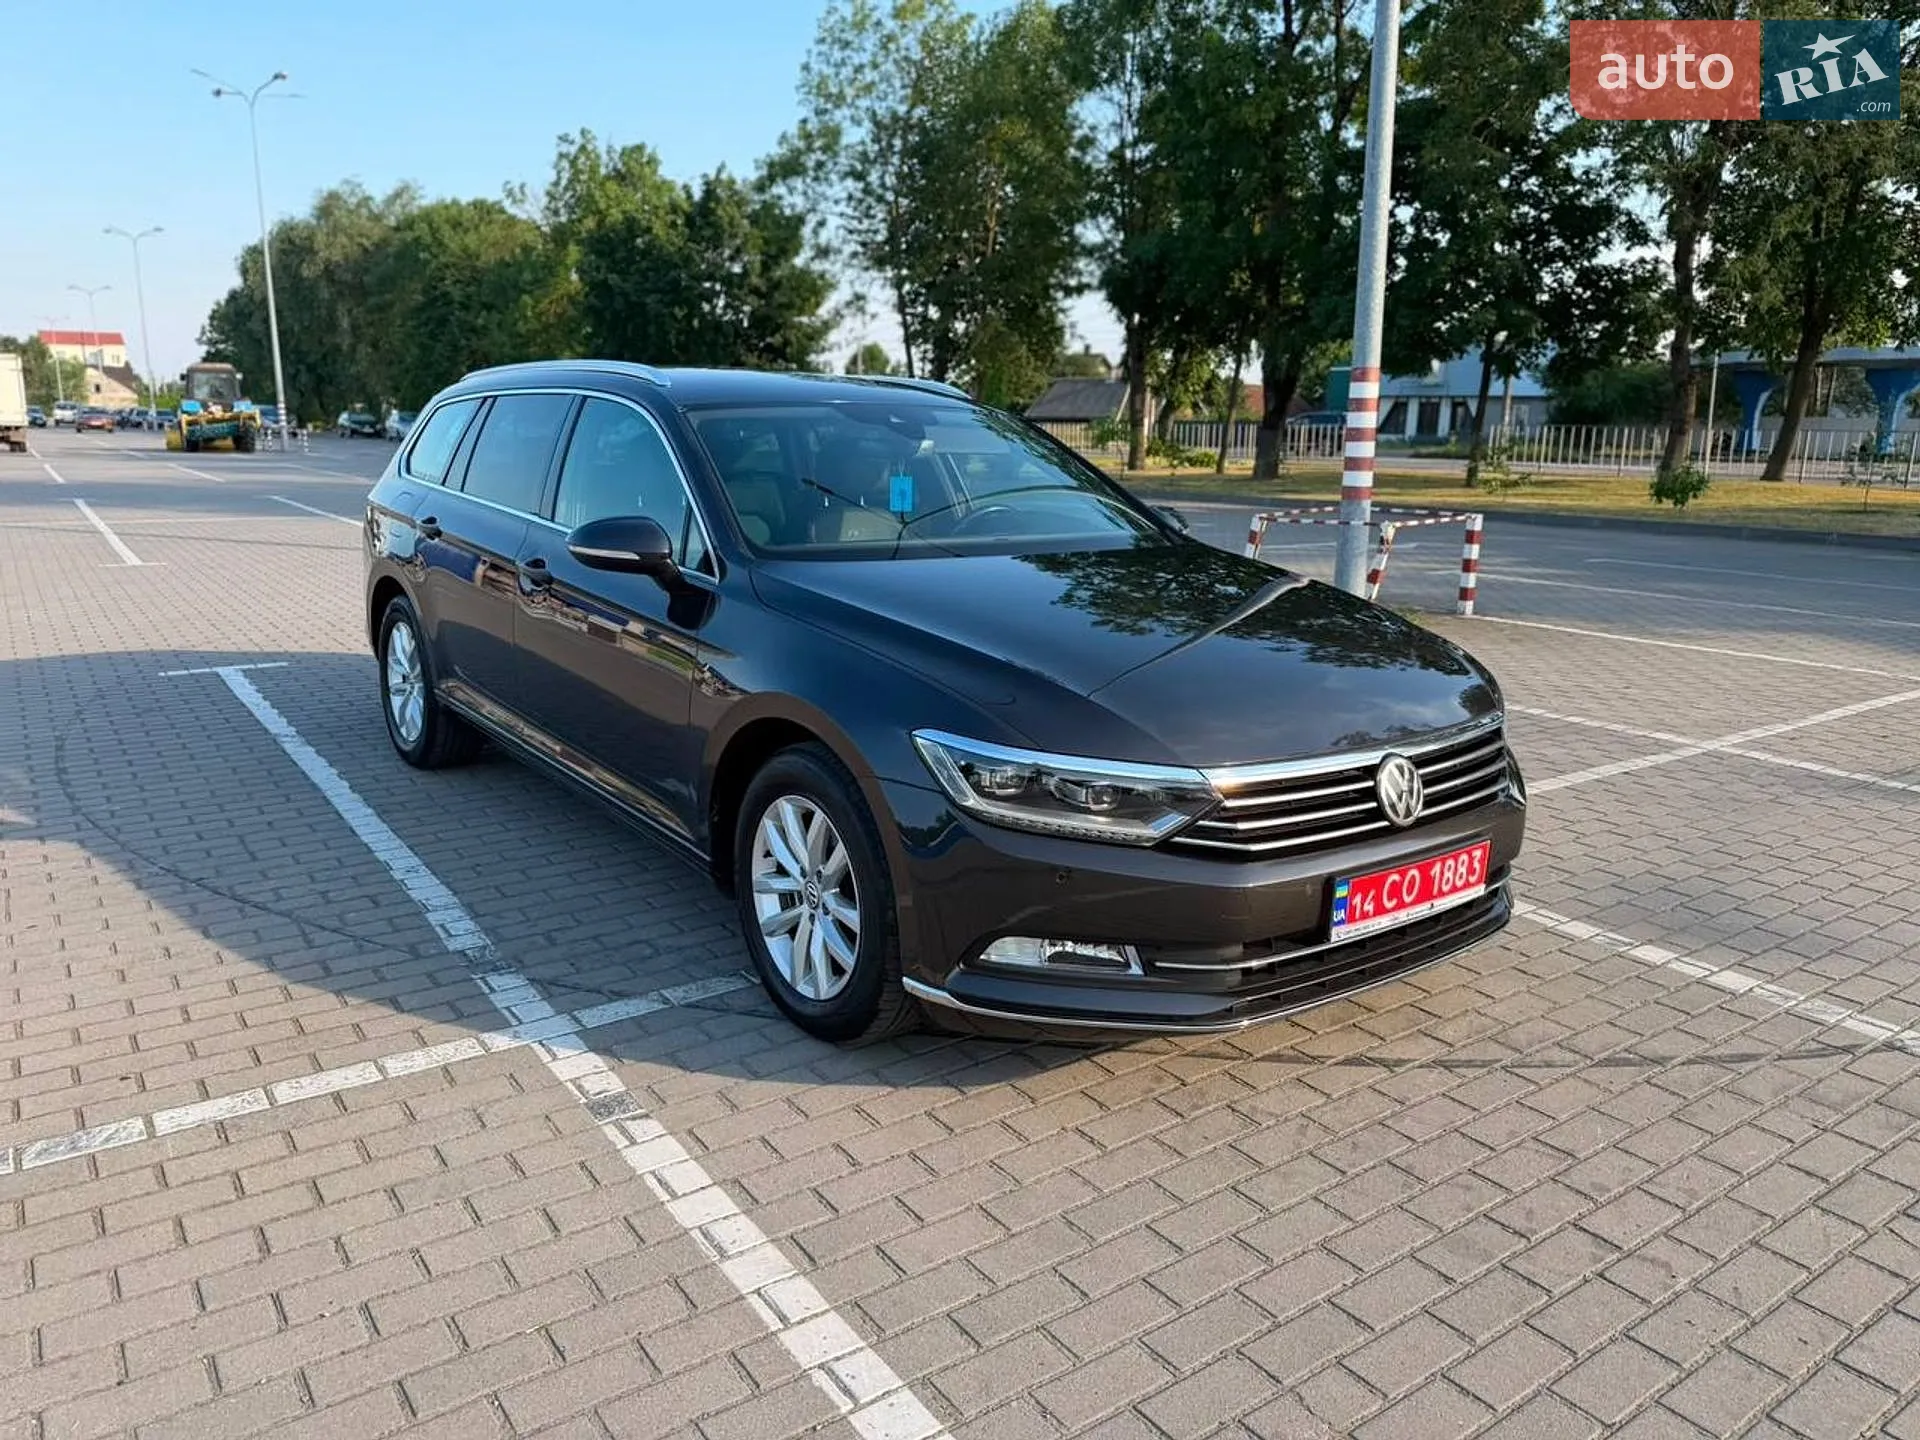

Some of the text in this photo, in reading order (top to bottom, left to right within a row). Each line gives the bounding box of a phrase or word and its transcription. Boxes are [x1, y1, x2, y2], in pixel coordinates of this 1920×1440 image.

[1352, 889, 1376, 920] 14
[1383, 868, 1421, 910] CO
[1431, 850, 1483, 895] 1883
[1333, 909, 1346, 922] UA
